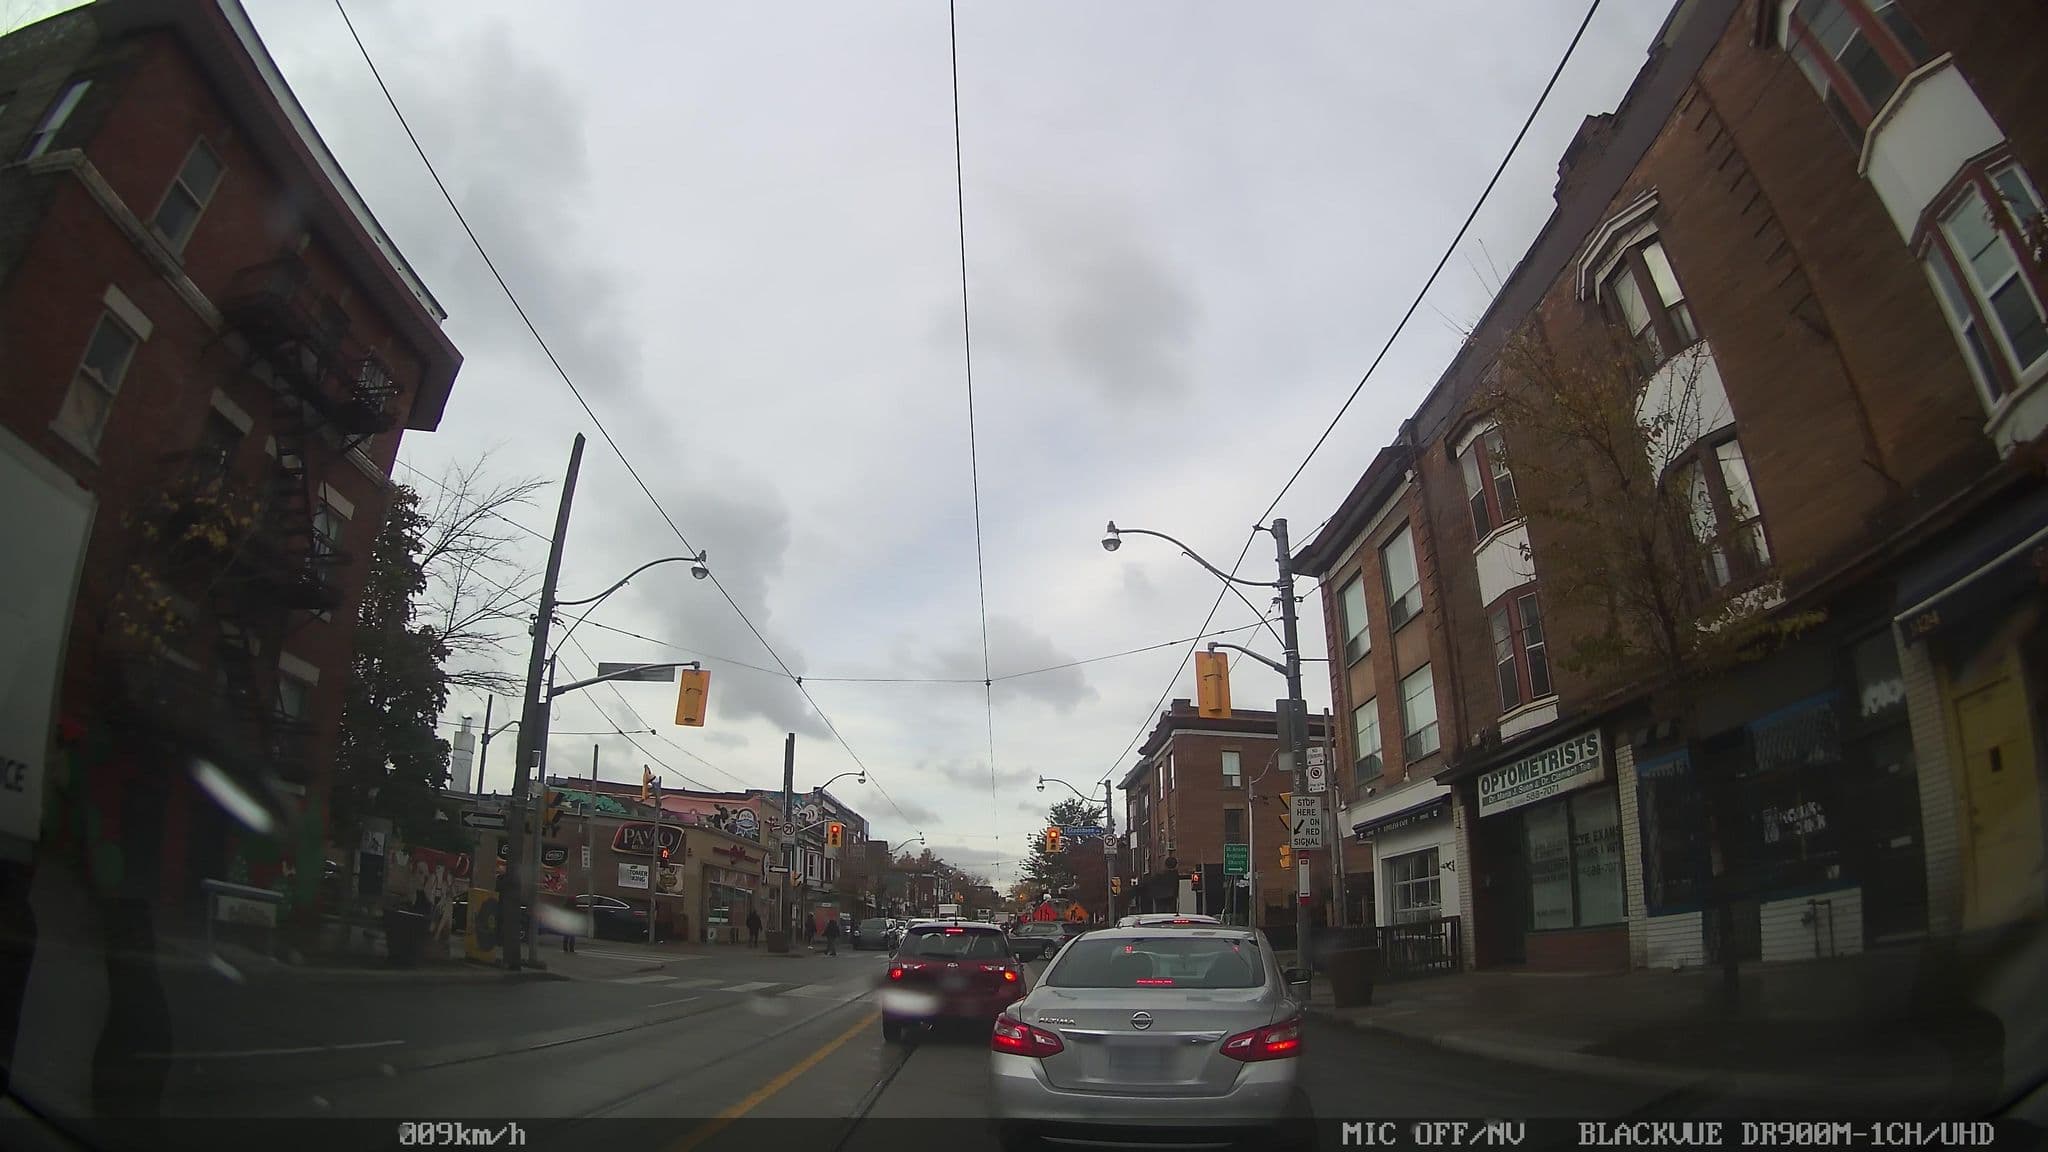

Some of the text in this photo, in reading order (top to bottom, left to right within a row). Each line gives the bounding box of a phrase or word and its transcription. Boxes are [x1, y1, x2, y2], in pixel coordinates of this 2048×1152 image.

[1481, 733, 1598, 795] OPTOMETRISTS
[1297, 798, 1315, 806] STOP
[624, 827, 673, 846] PAVO
[1294, 838, 1319, 846] SIGNAL
[1039, 1016, 1076, 1025] ALTIMA
